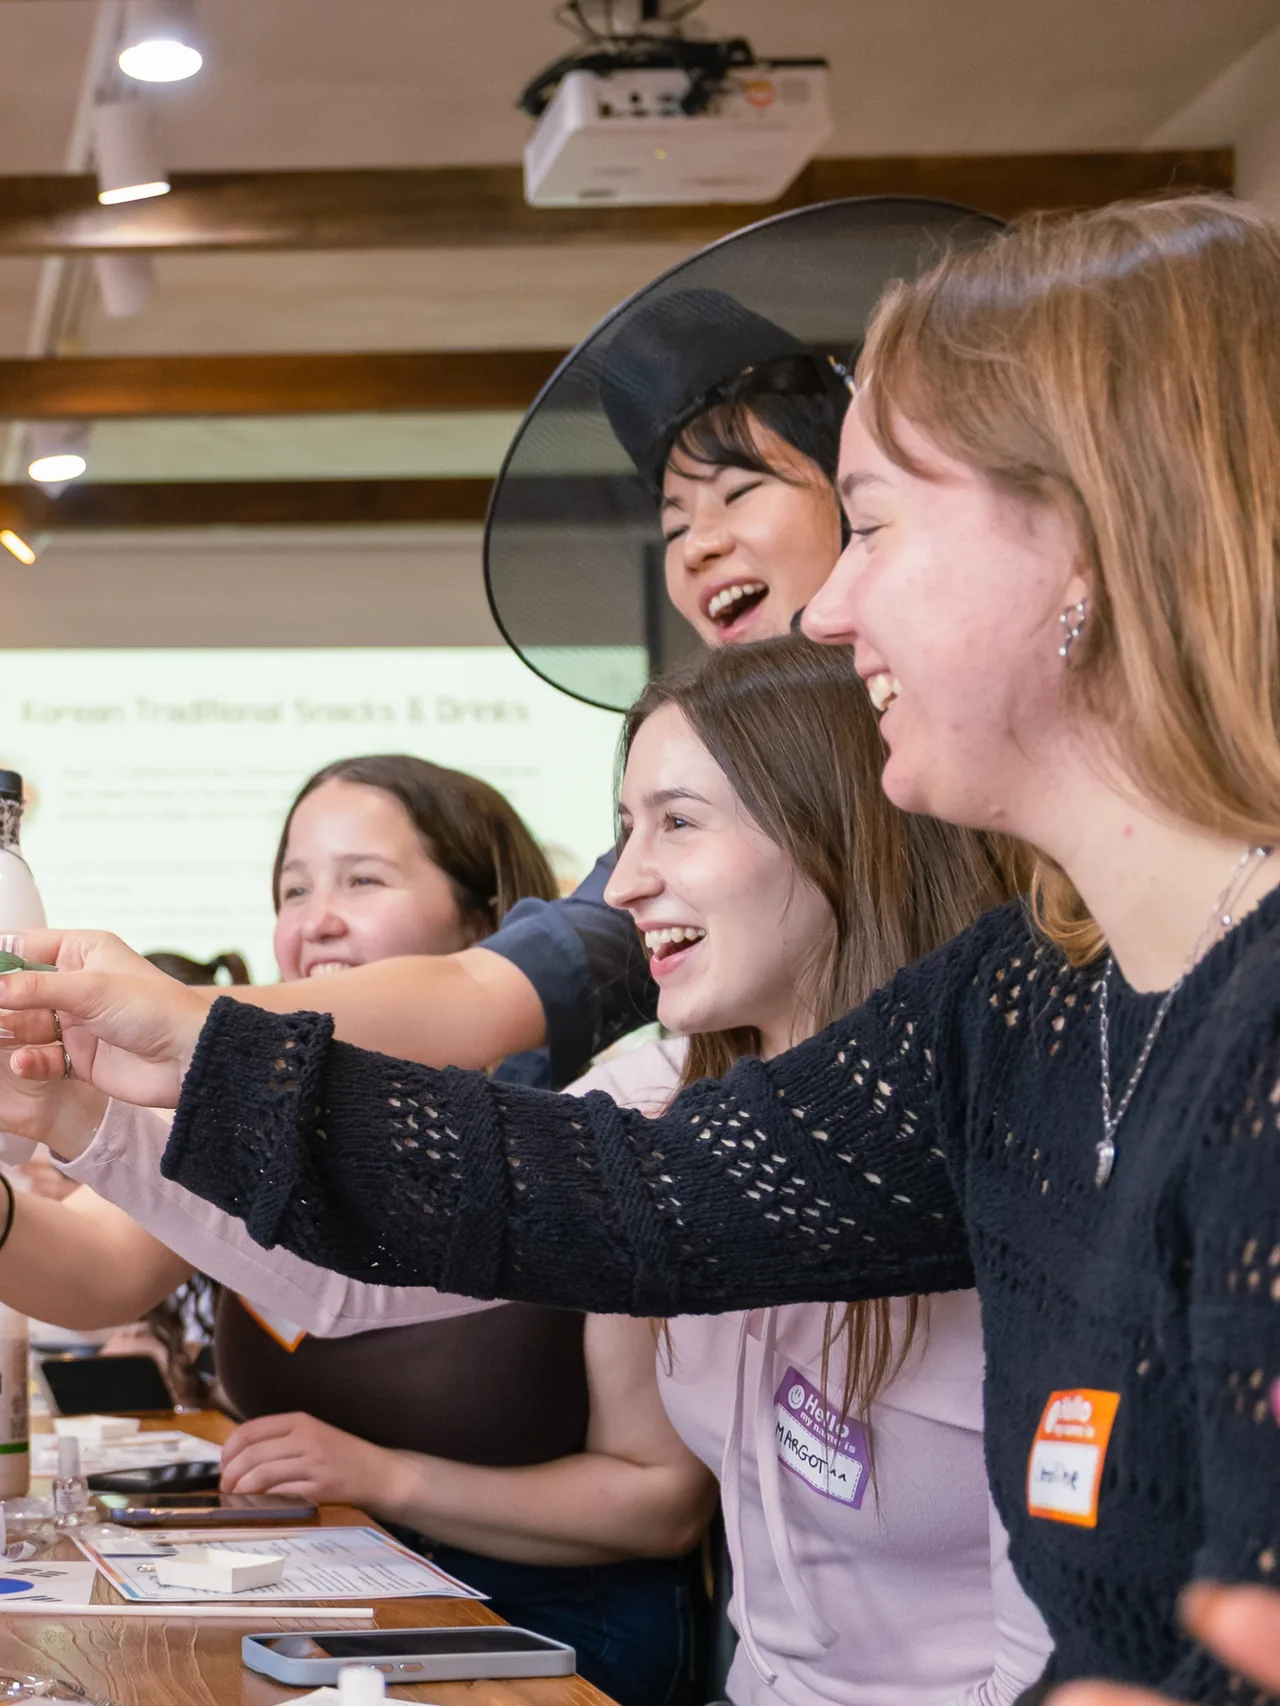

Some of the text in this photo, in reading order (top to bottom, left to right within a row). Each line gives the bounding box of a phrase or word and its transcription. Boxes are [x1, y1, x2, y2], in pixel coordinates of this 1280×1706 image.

[21, 697, 126, 725] Korean
[134, 695, 284, 725] Traditional
[293, 695, 398, 725] Snacks
[435, 695, 532, 725] Drinks
[799, 1411, 857, 1454] my name is
[804, 1393, 850, 1439] Hello
[774, 1420, 829, 1475] MARGOT
